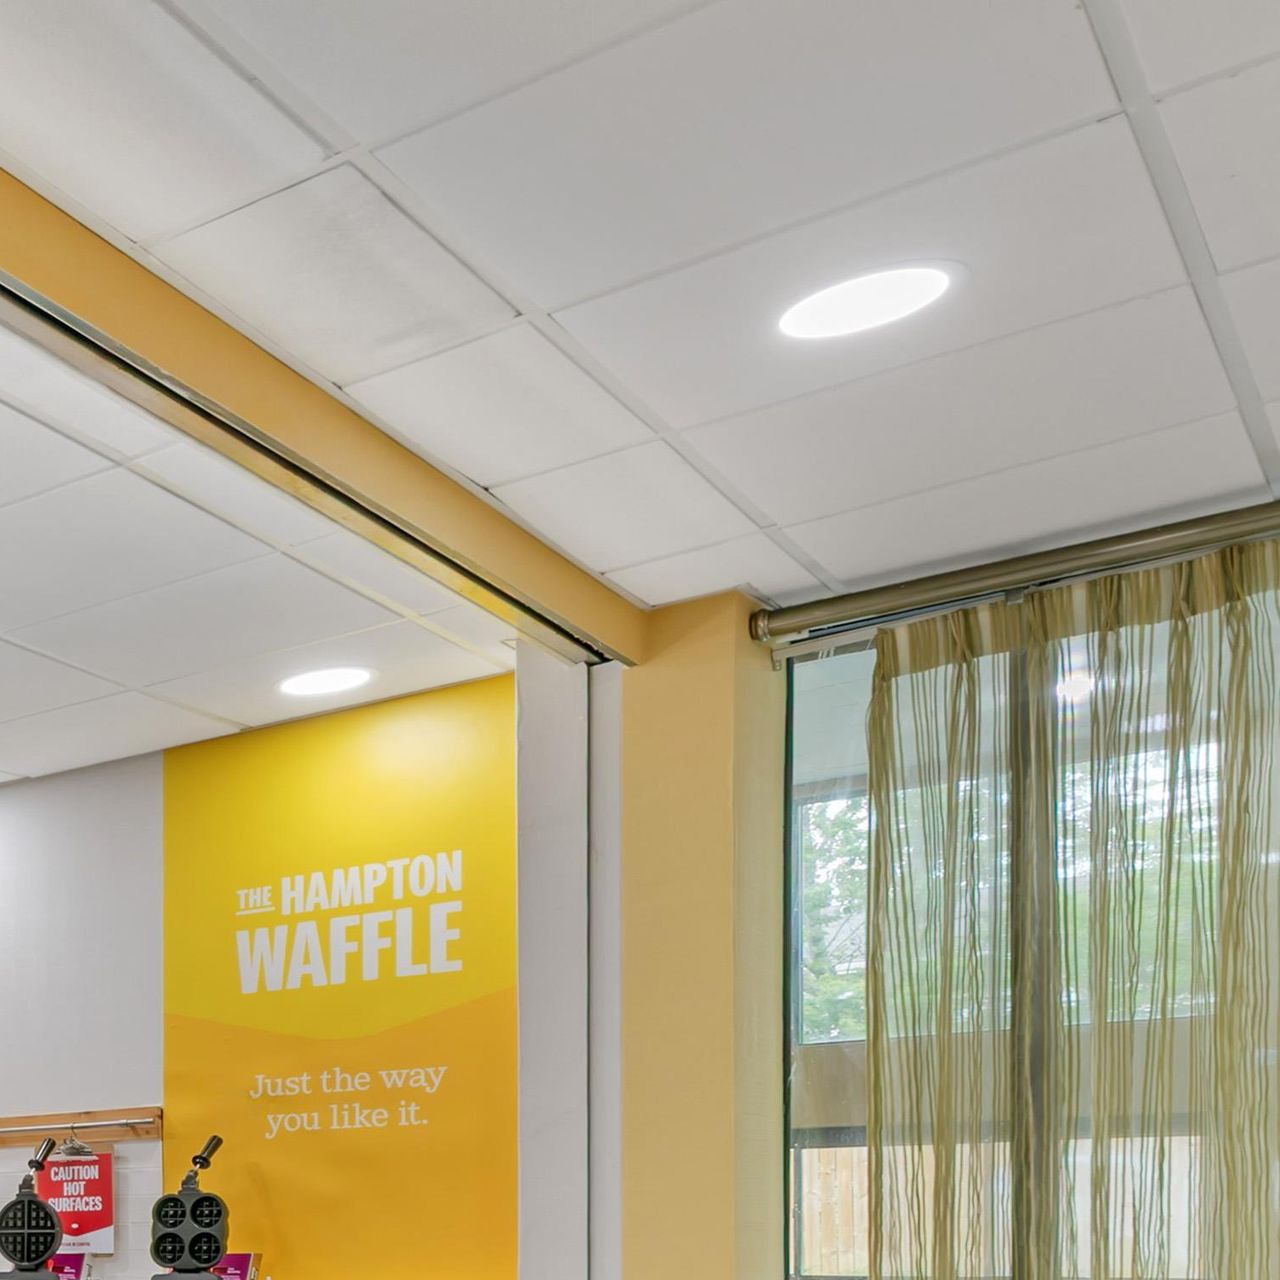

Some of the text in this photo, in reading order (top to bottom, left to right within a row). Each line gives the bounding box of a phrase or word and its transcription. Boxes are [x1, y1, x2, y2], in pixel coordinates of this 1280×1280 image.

[236, 849, 463, 916] THE HAMPTON
[235, 900, 463, 995] WAFFLE
[249, 1066, 447, 1099] Just the way
[265, 1100, 429, 1140] you like it.
[50, 1165, 100, 1181] CAUTION
[63, 1181, 86, 1196] HOT
[48, 1196, 103, 1212] SURFACES
